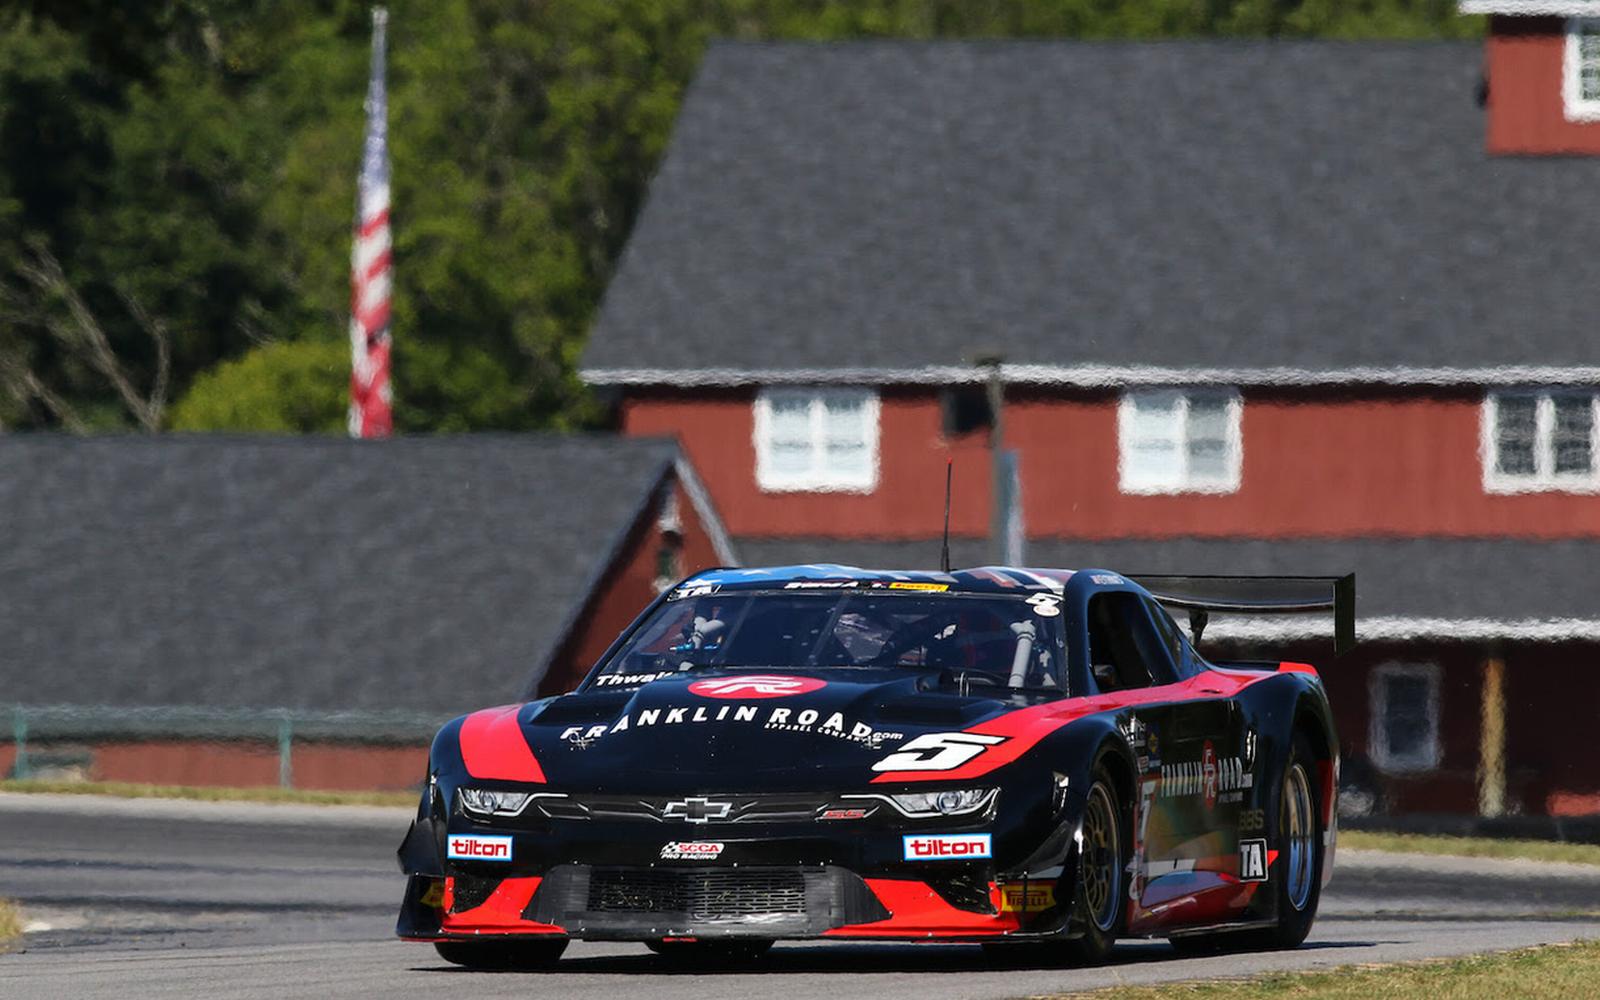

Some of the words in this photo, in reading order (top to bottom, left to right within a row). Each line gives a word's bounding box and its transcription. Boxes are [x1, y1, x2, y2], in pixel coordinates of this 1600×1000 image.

[560, 706, 758, 740] FRANKLIN
[769, 707, 873, 738] ROAD
[764, 722, 812, 734] APPAREL
[871, 732, 1006, 772] 5
[452, 838, 508, 857] tilton
[679, 843, 720, 853] SCCA
[910, 839, 985, 856] tilton
[1240, 843, 1264, 878] TA
